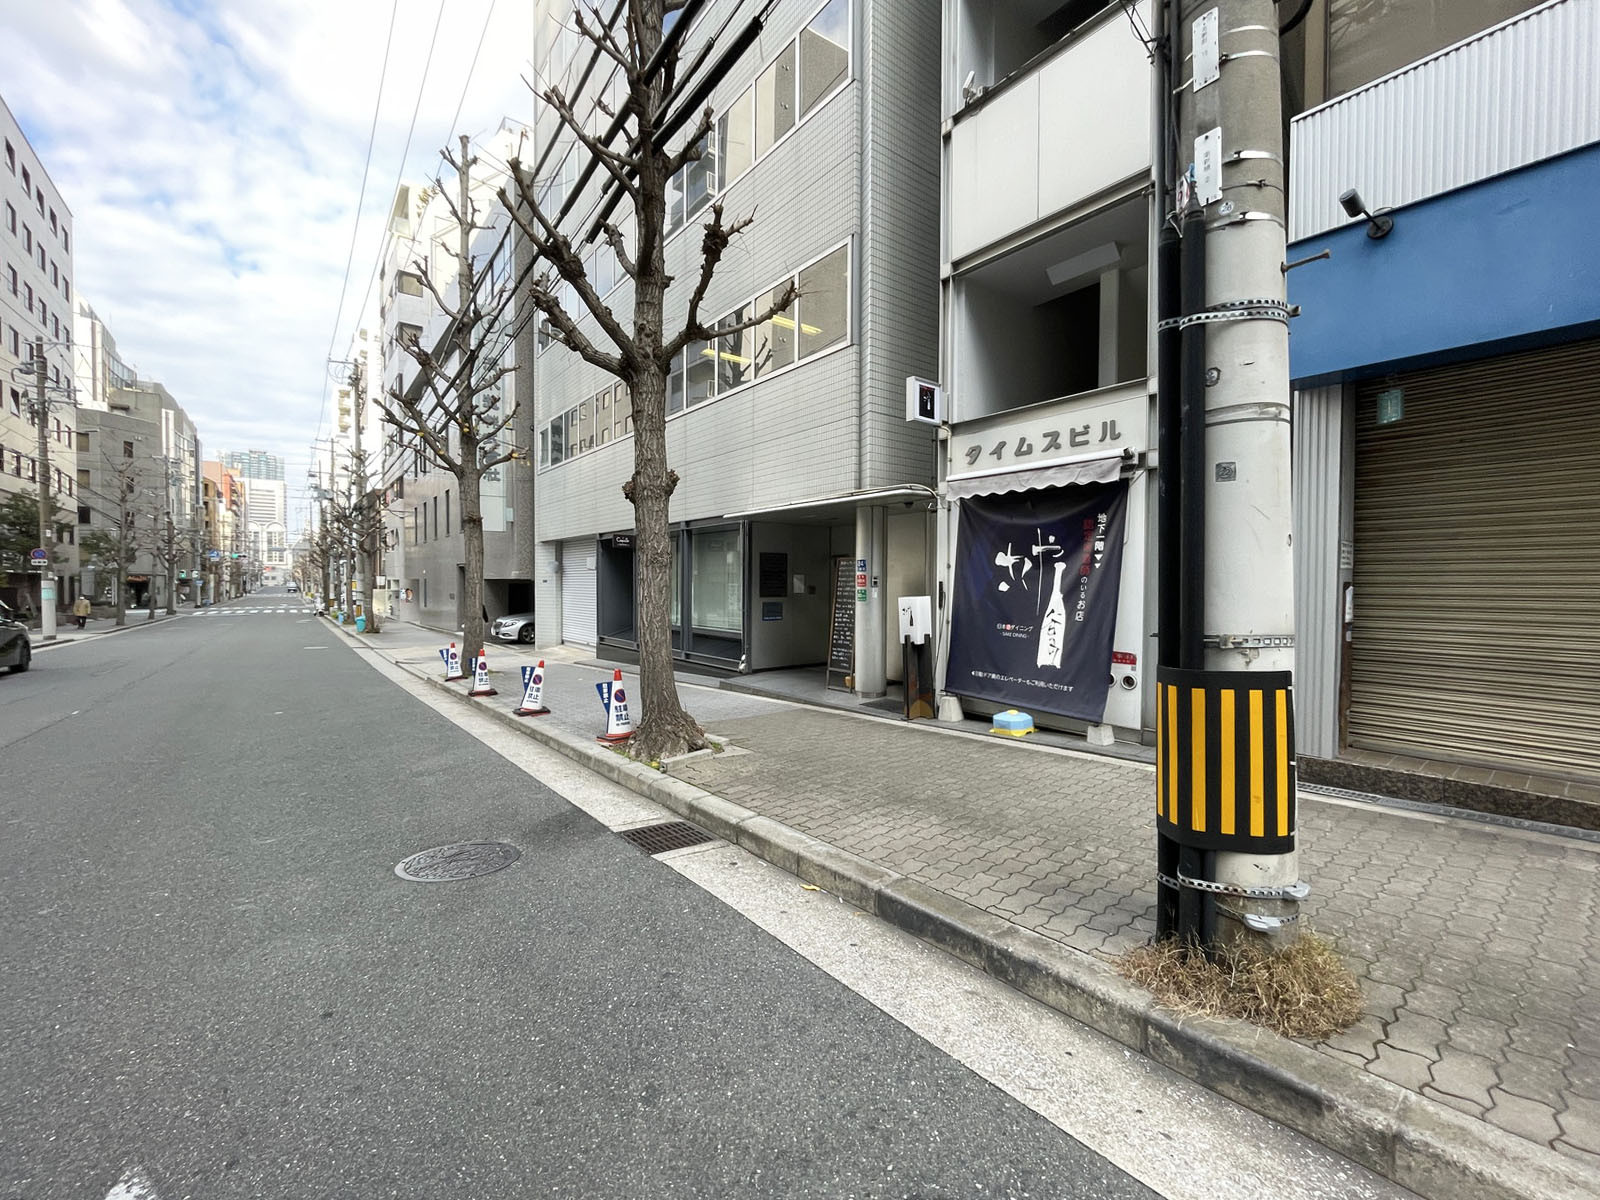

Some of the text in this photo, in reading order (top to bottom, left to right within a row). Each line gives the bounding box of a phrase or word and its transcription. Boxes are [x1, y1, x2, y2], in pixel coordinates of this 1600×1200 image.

[965, 420, 1121, 465] タイムスビル
